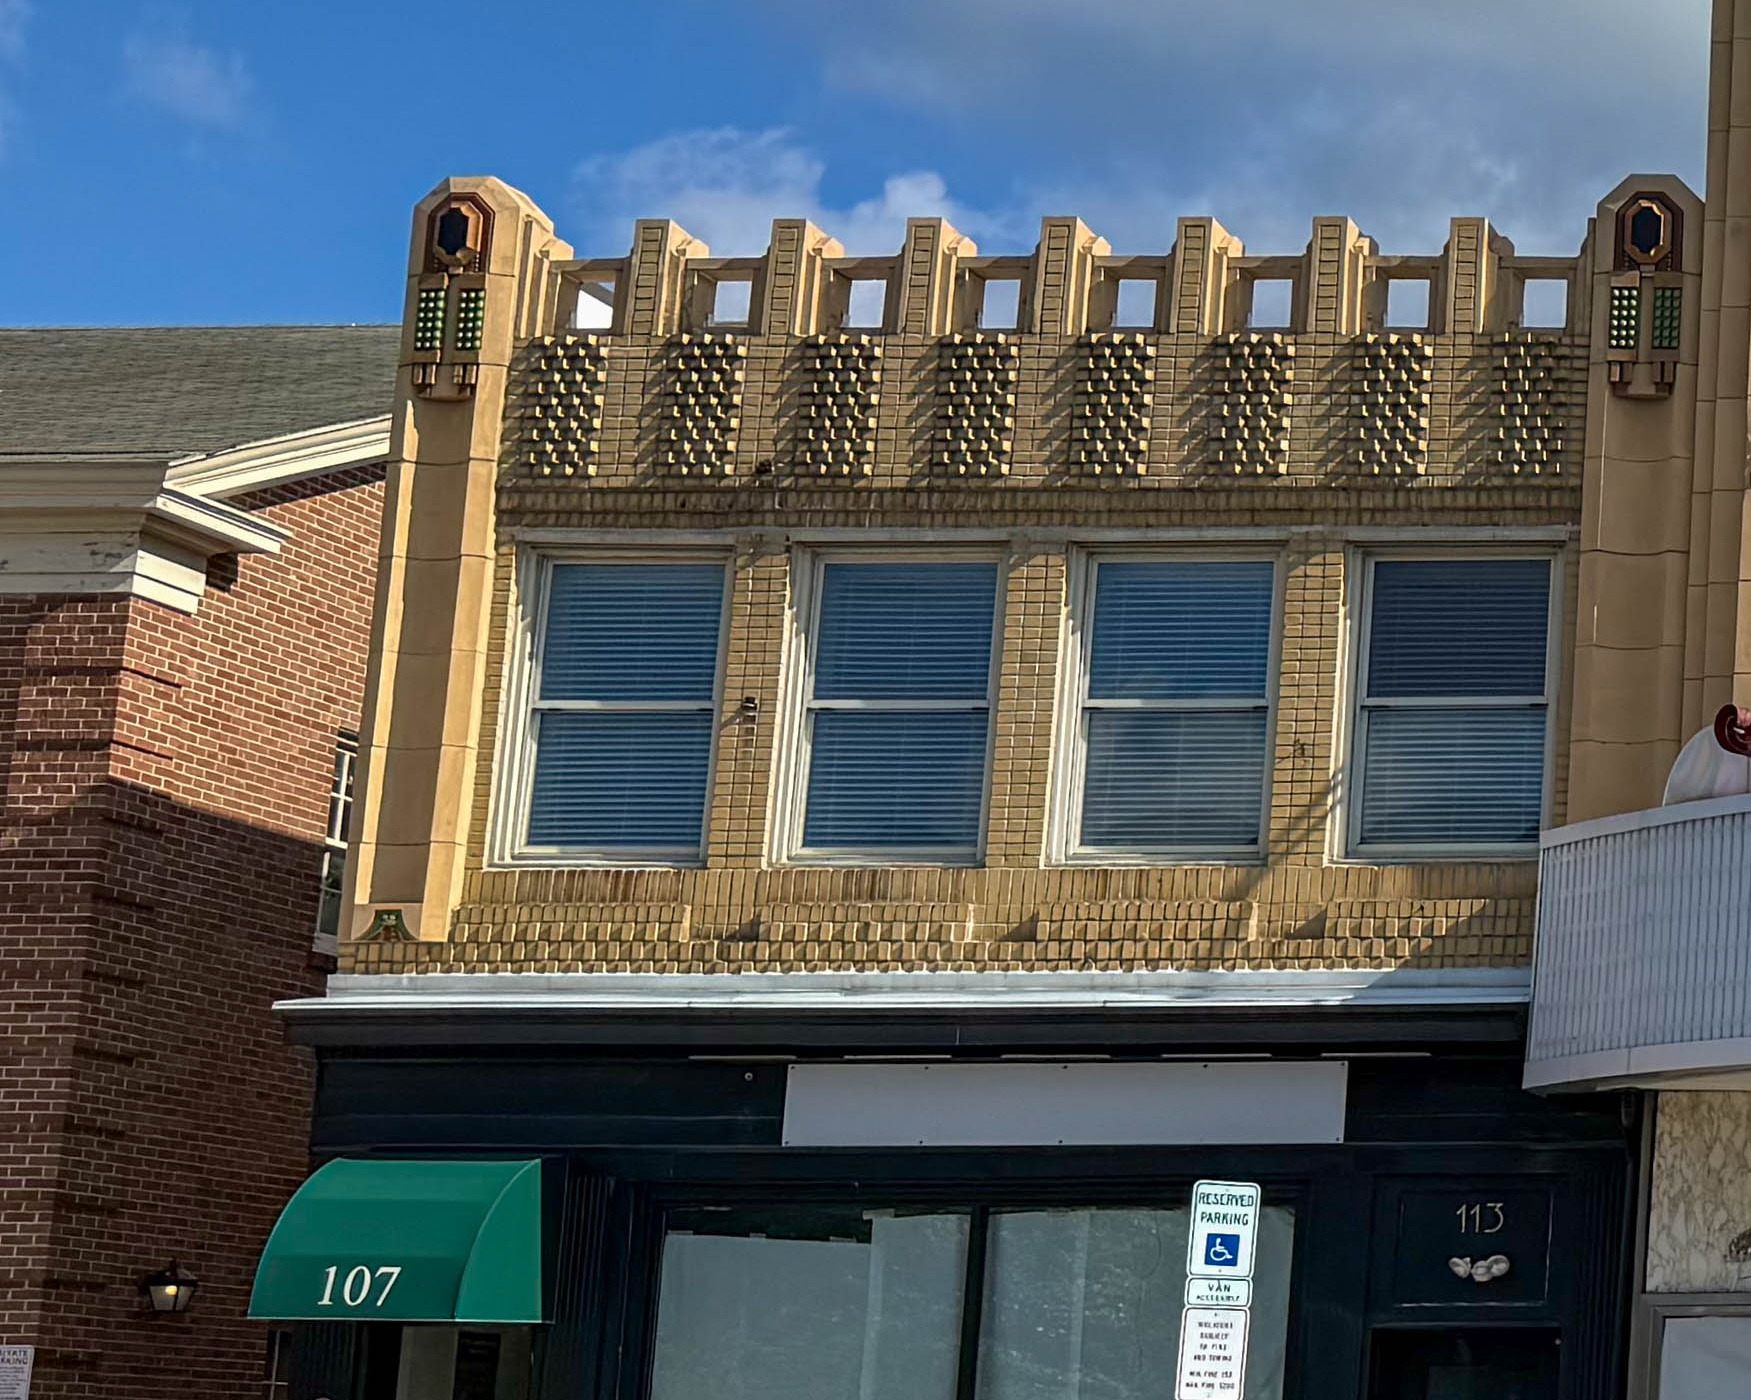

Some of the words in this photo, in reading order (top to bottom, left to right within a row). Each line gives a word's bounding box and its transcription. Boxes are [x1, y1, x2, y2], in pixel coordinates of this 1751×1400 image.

[1198, 1192, 1255, 1207] RESERVED
[1200, 1211, 1249, 1226] PARKING
[1456, 1202, 1504, 1234] 113
[317, 1265, 402, 1307] 107
[1207, 1283, 1231, 1293] VAN
